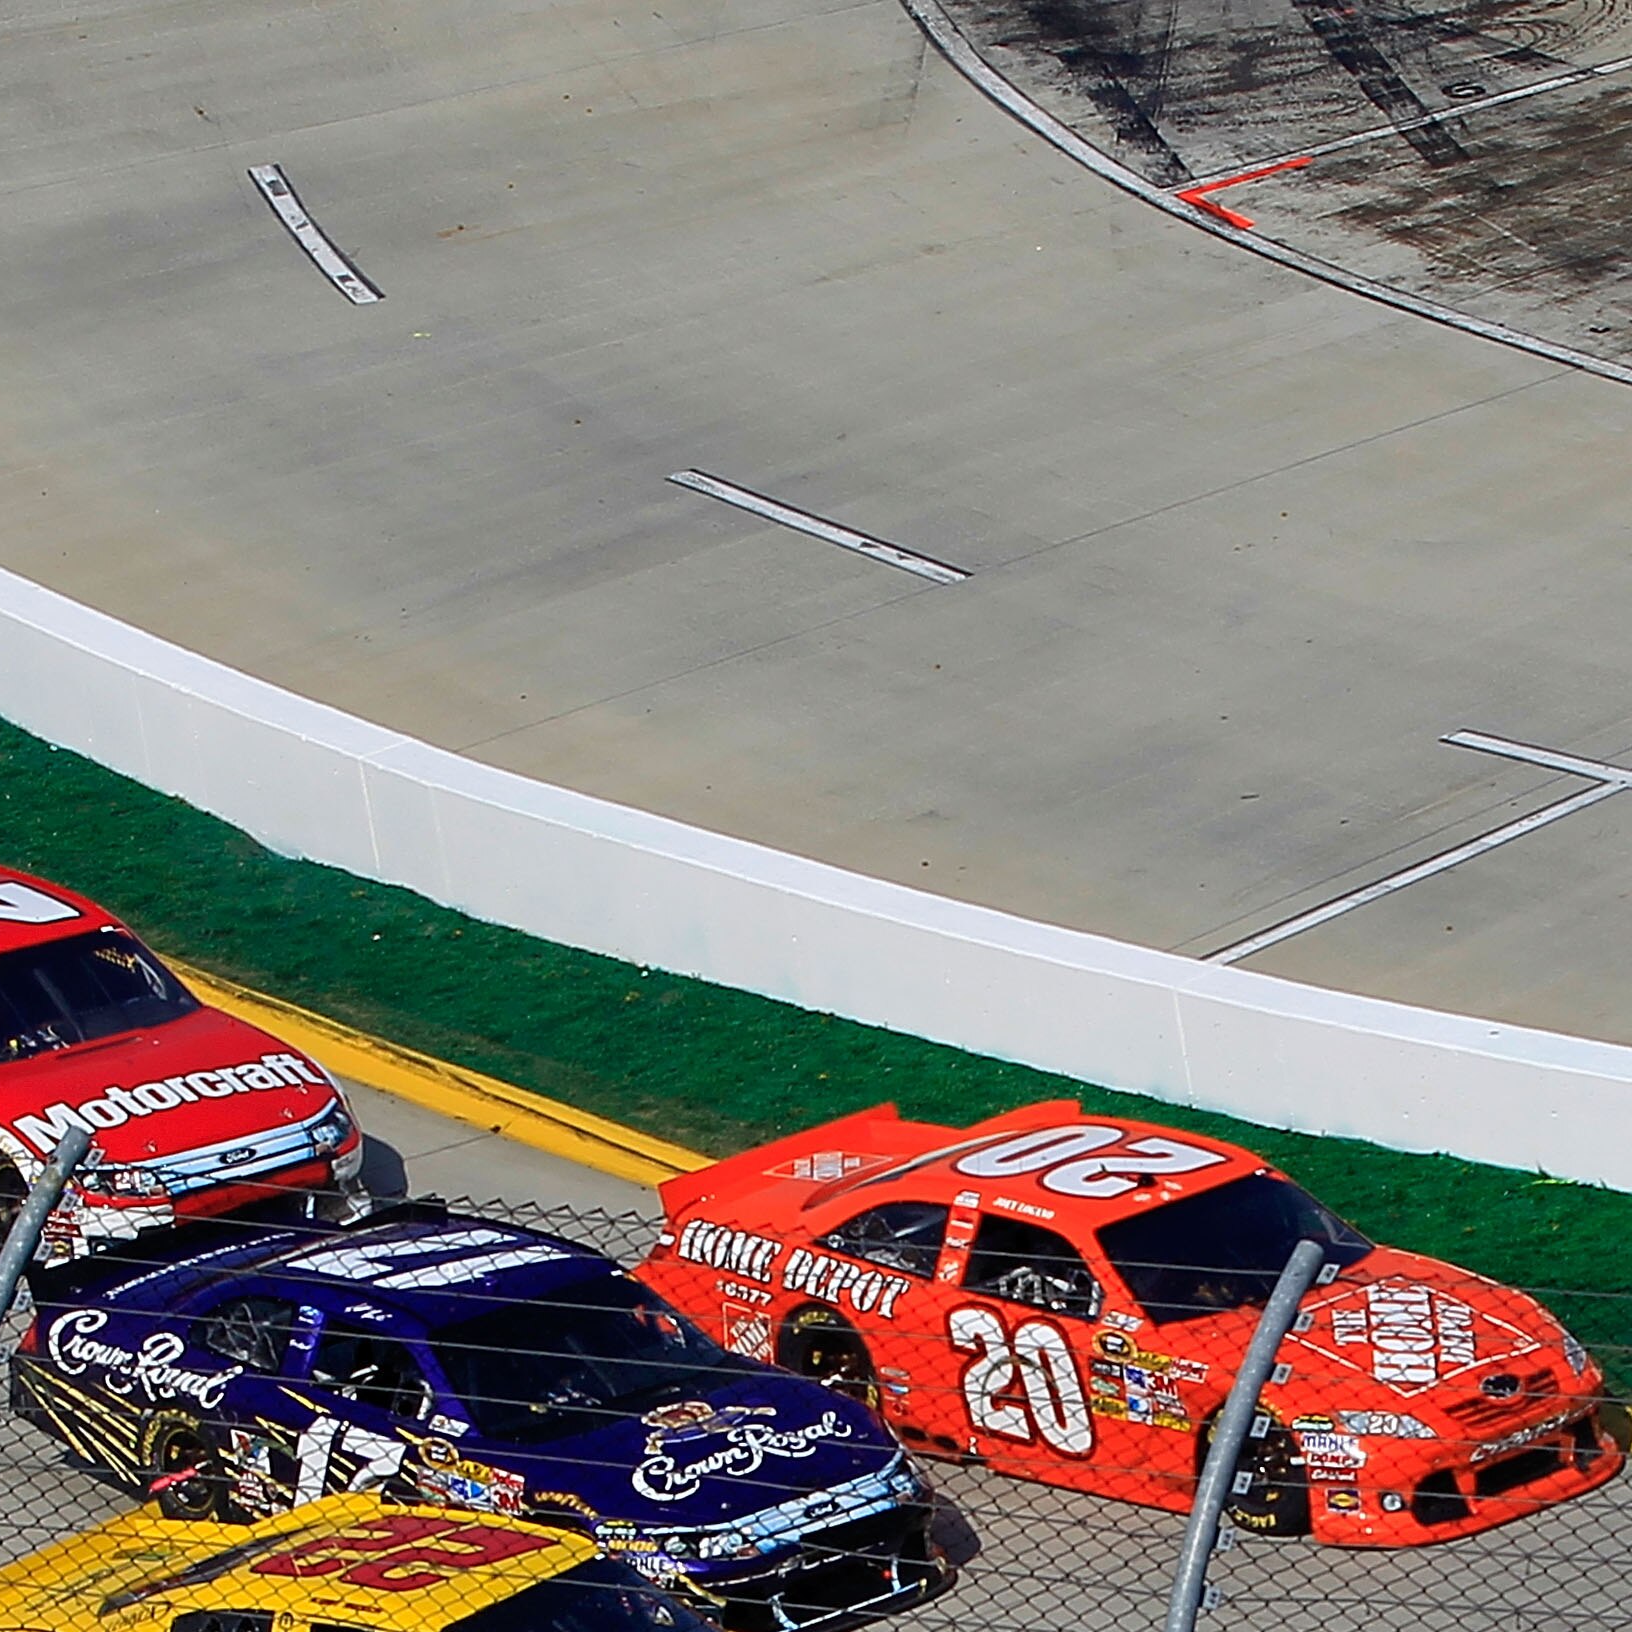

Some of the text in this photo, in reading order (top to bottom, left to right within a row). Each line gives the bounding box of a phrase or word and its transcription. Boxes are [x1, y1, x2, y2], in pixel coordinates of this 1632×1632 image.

[11, 1051, 328, 1155] Motorcraft
[678, 1217, 912, 1319] HOME DEPOT
[48, 1309, 244, 1410] Crown Royal
[1331, 1308, 1368, 1347] THE
[1368, 1284, 1437, 1383] HOME
[947, 1304, 1095, 1457] 20
[294, 1416, 406, 1507] 17
[631, 1410, 853, 1501] Crown Royal
